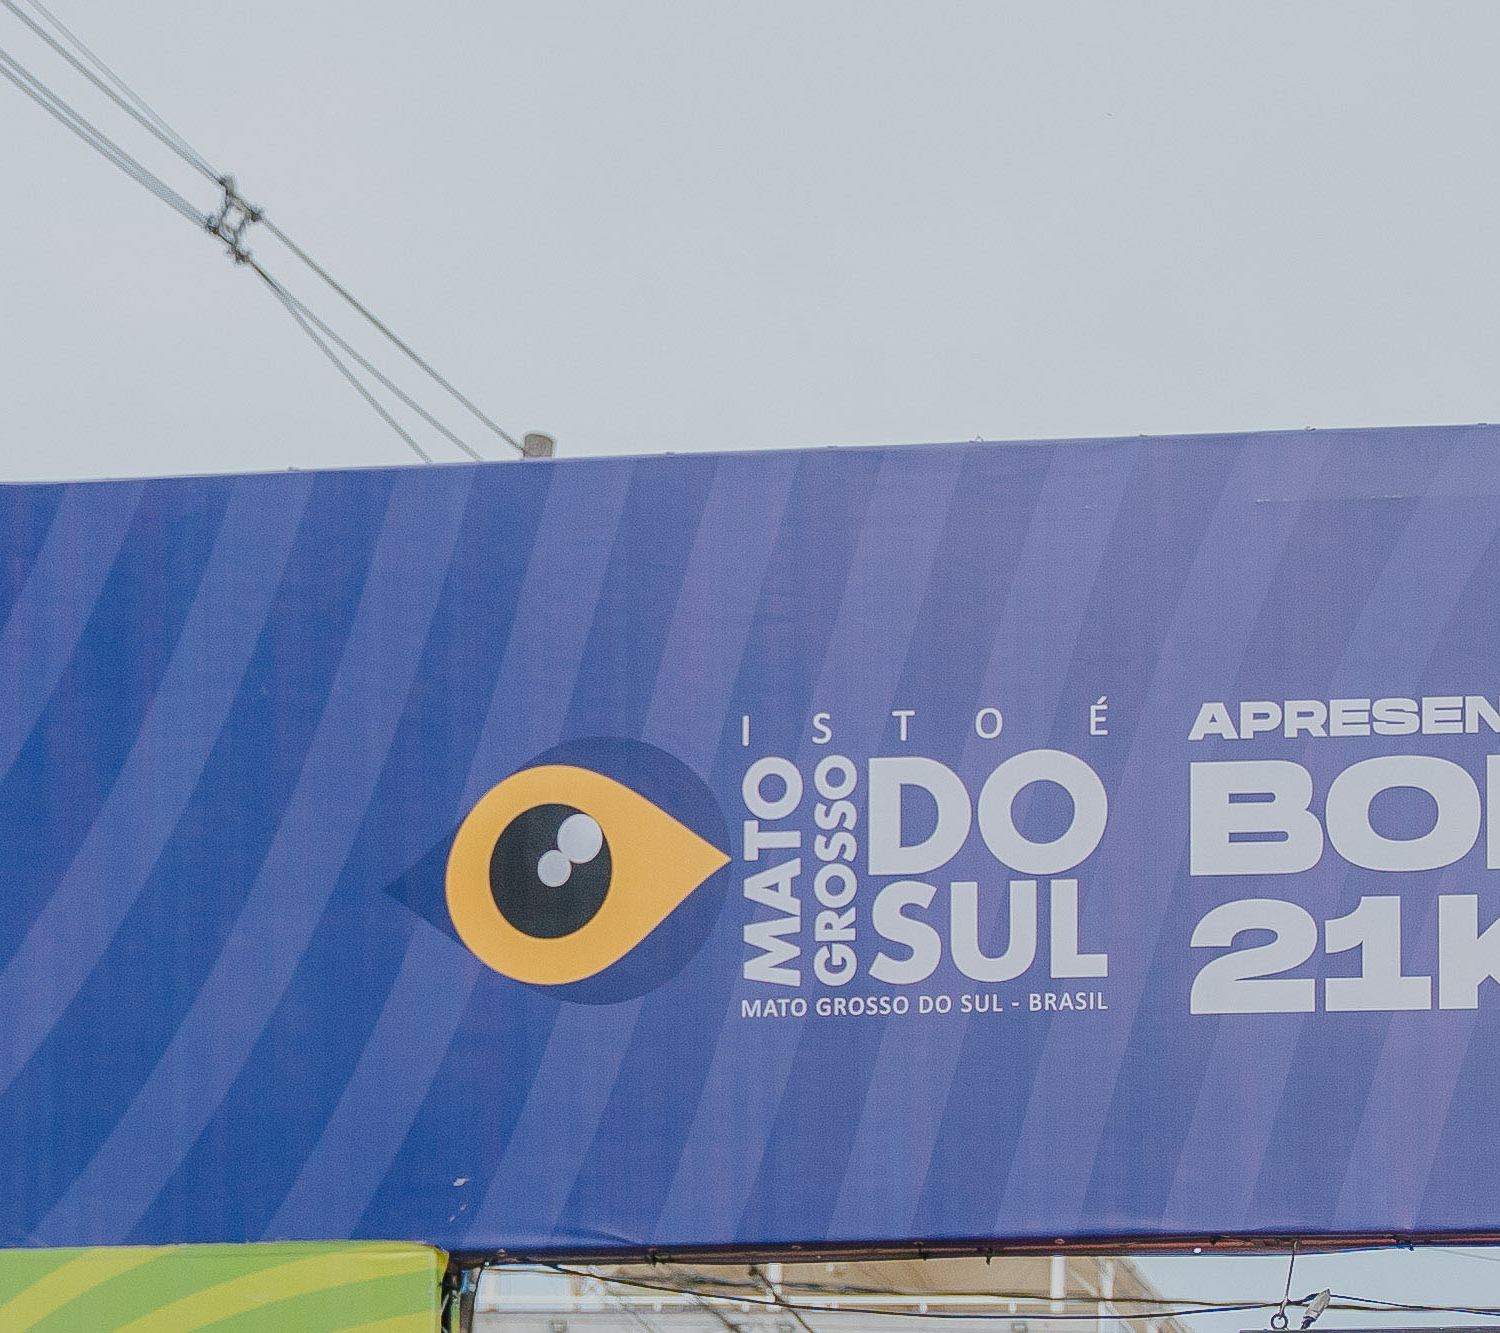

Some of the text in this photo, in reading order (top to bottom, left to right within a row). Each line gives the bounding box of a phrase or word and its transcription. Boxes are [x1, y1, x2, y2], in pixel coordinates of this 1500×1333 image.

[742, 756, 803, 987] MATO
[814, 754, 858, 987] GROSSO
[868, 749, 1108, 876] DO
[868, 879, 1108, 985] SUL
[741, 999, 808, 1018] MATO
[815, 996, 910, 1017] GROSSO
[919, 995, 952, 1014] DO
[960, 994, 1004, 1013] SUL
[1028, 992, 1108, 1012] BRASIL
